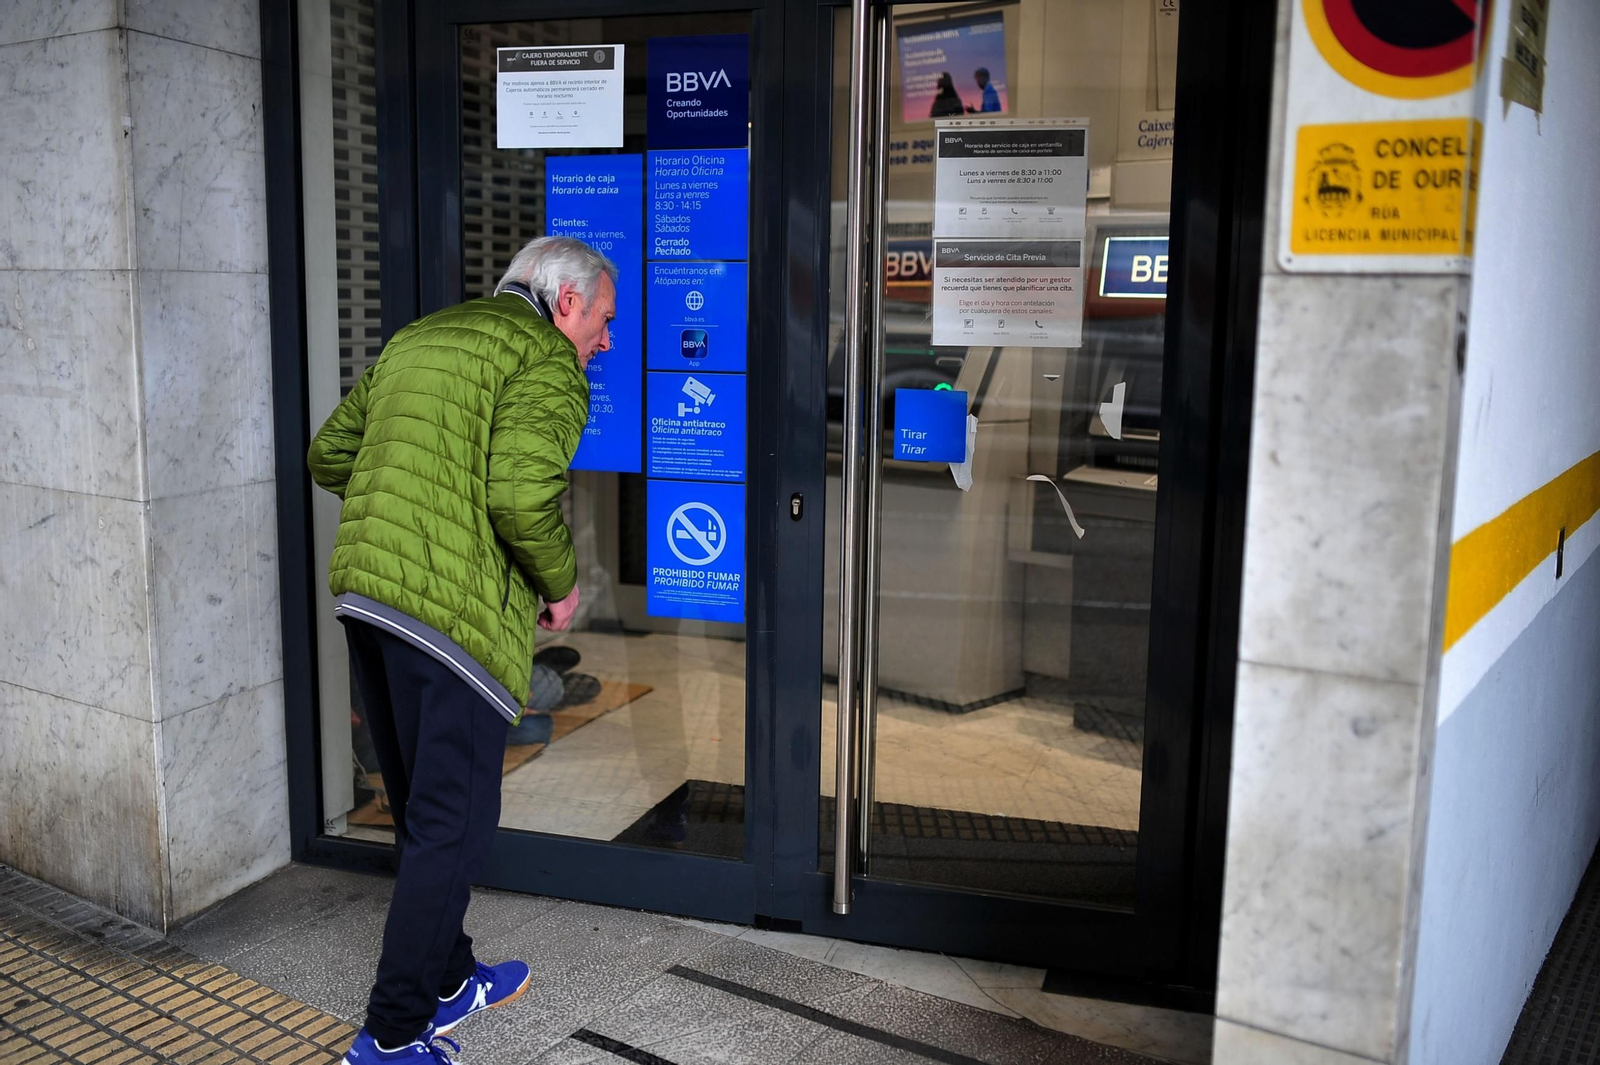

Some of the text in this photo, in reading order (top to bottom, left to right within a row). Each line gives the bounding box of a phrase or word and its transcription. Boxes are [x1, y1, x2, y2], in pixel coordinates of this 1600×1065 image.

[666, 68, 732, 92] BBVA
[666, 99, 701, 108] Creando
[666, 109, 728, 119] Oportunidades
[1375, 136, 1474, 158] CONCEL
[655, 155, 725, 166] Horario Oficina
[655, 166, 724, 176] Horario Oficina
[585, 174, 596, 182] de
[598, 174, 615, 184] caja
[1373, 170, 1401, 189] DE
[552, 186, 619, 194] Horario de caixa
[655, 181, 680, 190] Lunes
[688, 181, 718, 189] viernes
[655, 191, 674, 199] Luns
[655, 201, 674, 210] 8:30
[681, 201, 701, 210] 14:15
[552, 218, 588, 226] Clientes:
[655, 214, 691, 223] Sábados
[655, 224, 690, 232] Sábados
[565, 230, 586, 238] lunes
[595, 230, 626, 239] viernes,
[1304, 229, 1371, 242] LICENCIA
[1380, 228, 1459, 242] MUNICIPAL
[592, 241, 613, 250] 11:00
[655, 237, 689, 246] Cerrado
[655, 247, 691, 255] Pechado
[654, 266, 708, 275] Encuéntranos
[654, 276, 690, 286] Atópanos
[591, 404, 614, 414] 10:30,
[652, 418, 726, 429] Oficina antiatraco
[584, 427, 601, 436] mes
[652, 426, 722, 436] Oficina antiatraco
[901, 429, 927, 440] Tirar
[901, 444, 926, 454] Tirar
[653, 567, 741, 582] PROHIBIDO FUMAR
[654, 576, 739, 591] PROHIBIDO FUMAR
